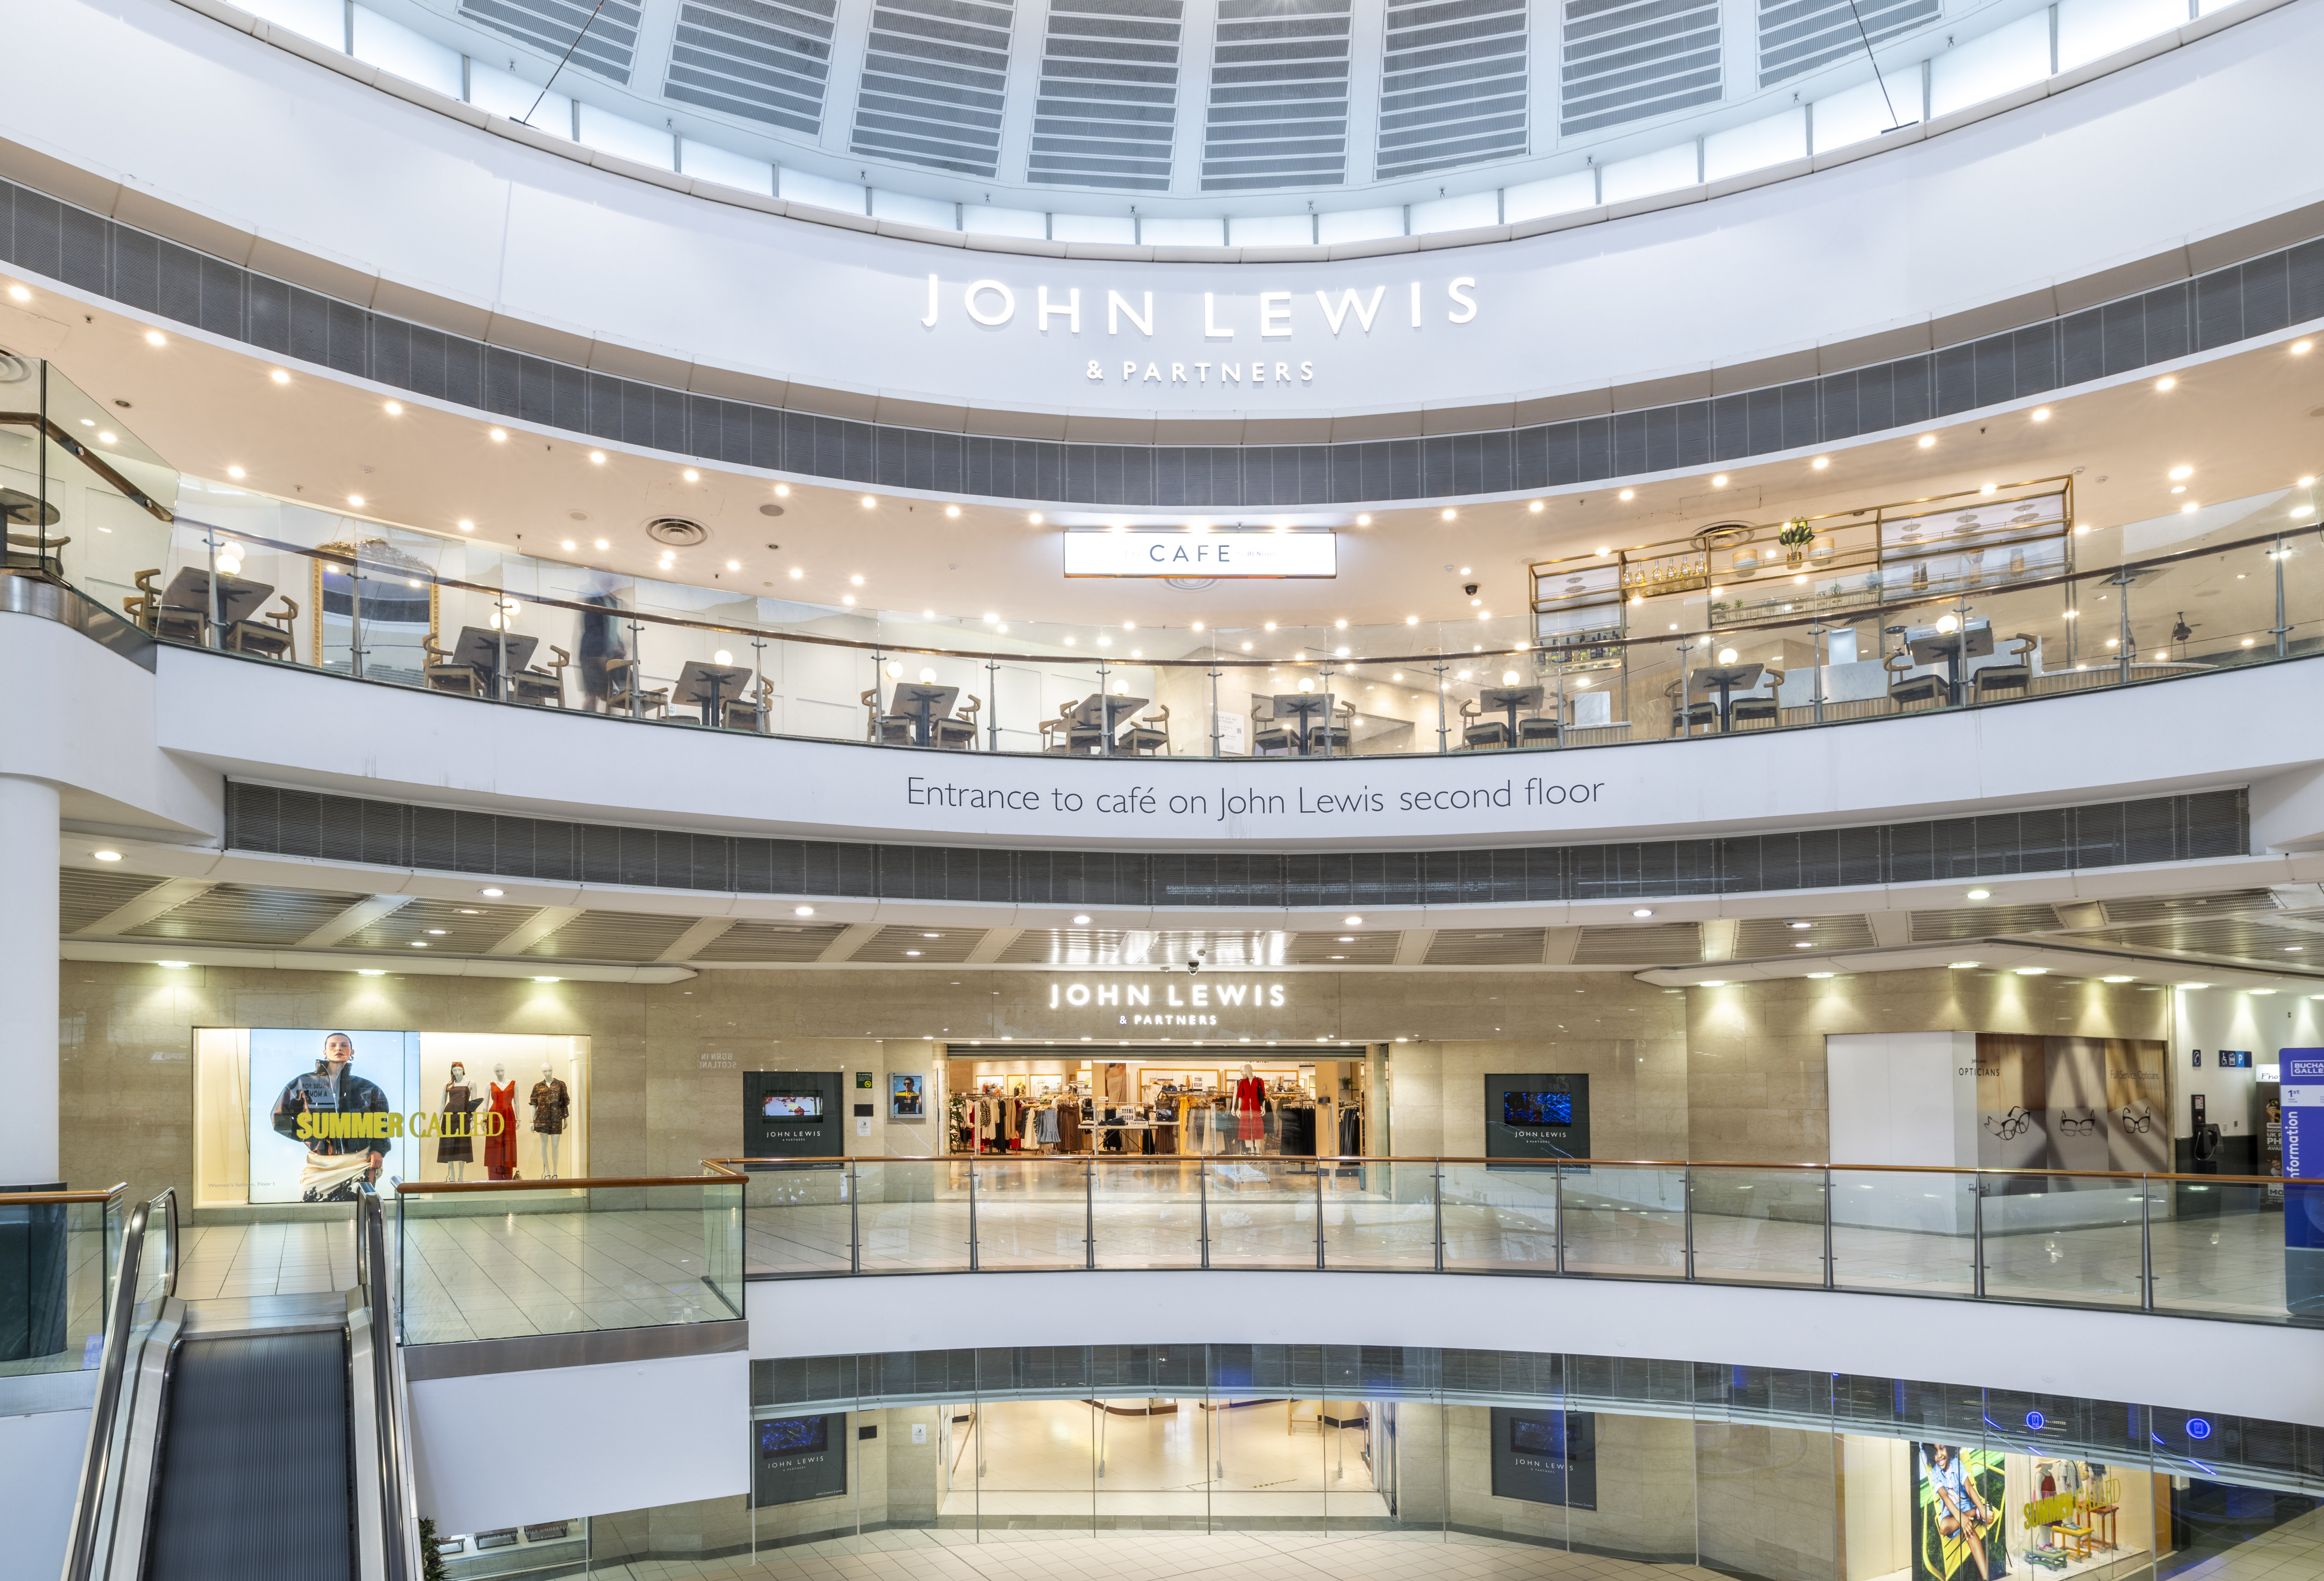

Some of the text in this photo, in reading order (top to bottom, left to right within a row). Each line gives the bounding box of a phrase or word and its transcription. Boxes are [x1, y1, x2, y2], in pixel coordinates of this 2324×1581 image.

[921, 273, 1477, 337] JOHN LEWIS
[1086, 360, 1313, 382] & PARTNERS
[1150, 544, 1230, 562] CAFE
[908, 776, 1605, 822] Entrance to café on John Lewis second floor
[1049, 984, 1285, 1009] JOHN LEWIS
[1119, 1015, 1217, 1025] & PARTNERS
[1959, 1068, 1999, 1076] OPTICIANS
[2110, 1070, 2159, 1081] Full Service Opticians
[296, 1111, 505, 1140] SUMMER CALLED
[2284, 1111, 2300, 1179] nformation
[1987, 1183, 1991, 1193] 1
[768, 1456, 824, 1469] JOHN LEWIS
[1515, 1458, 1573, 1471] JOHN LEWS
[2023, 1478, 2121, 1530] SUMMER CALLED
[503, 1529, 538, 1537] KNONGLY
[540, 1524, 569, 1533] UNDERSO
